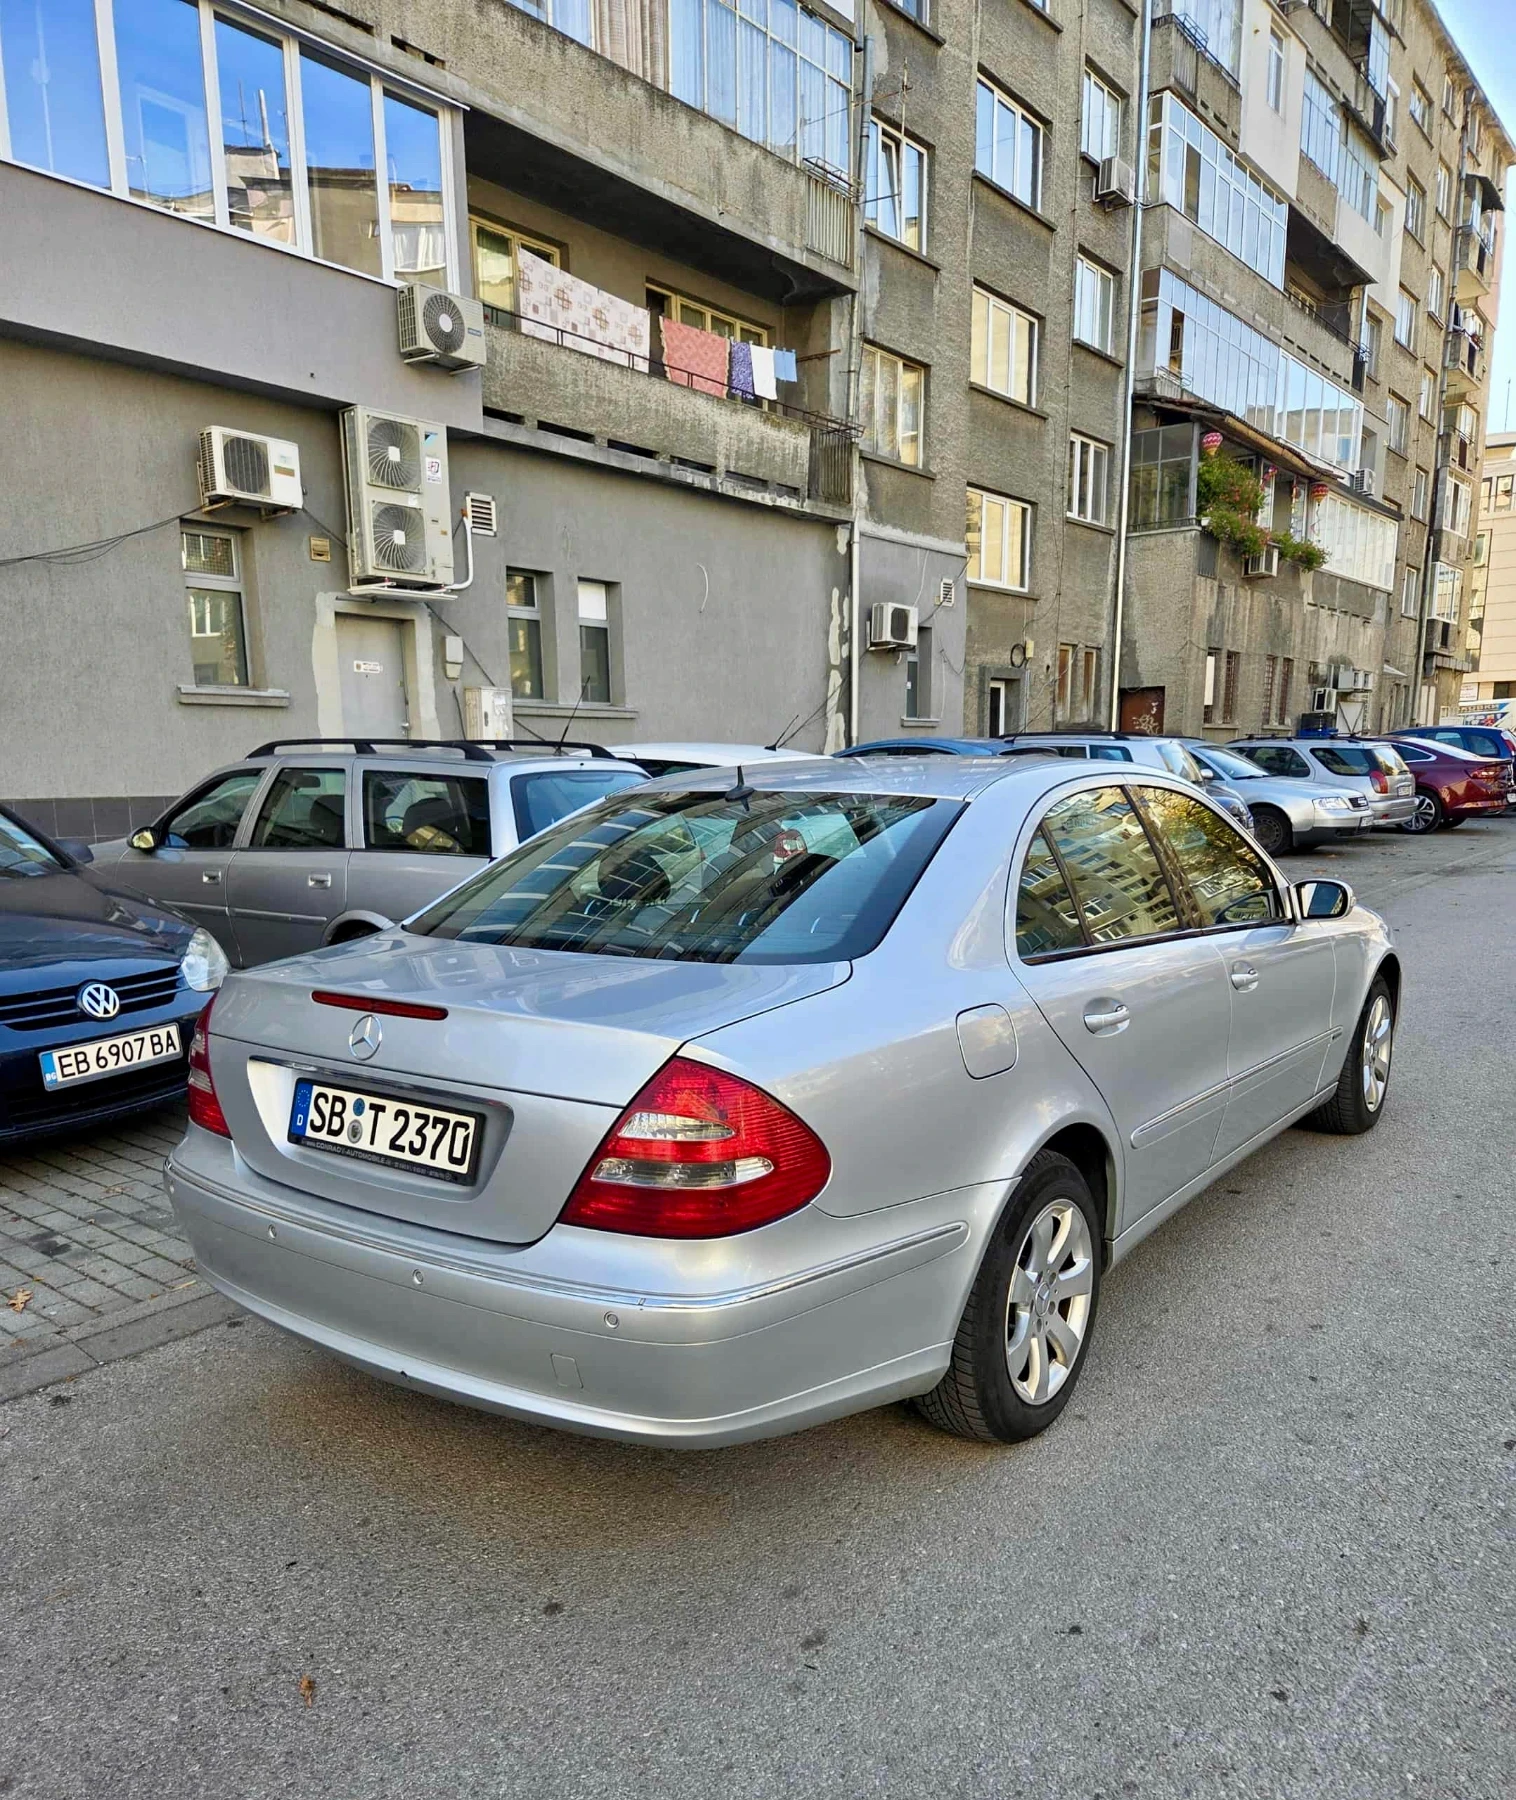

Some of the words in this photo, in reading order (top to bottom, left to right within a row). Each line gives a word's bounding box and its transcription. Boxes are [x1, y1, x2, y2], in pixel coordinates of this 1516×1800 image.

[58, 1051, 90, 1078] EB
[96, 1037, 145, 1069] 6907
[150, 1031, 177, 1056] BA
[45, 1073, 57, 1081] BG
[296, 1114, 304, 1126] D
[309, 1092, 347, 1137] SB
[368, 1102, 386, 1146] T
[389, 1109, 470, 1166] 2370
